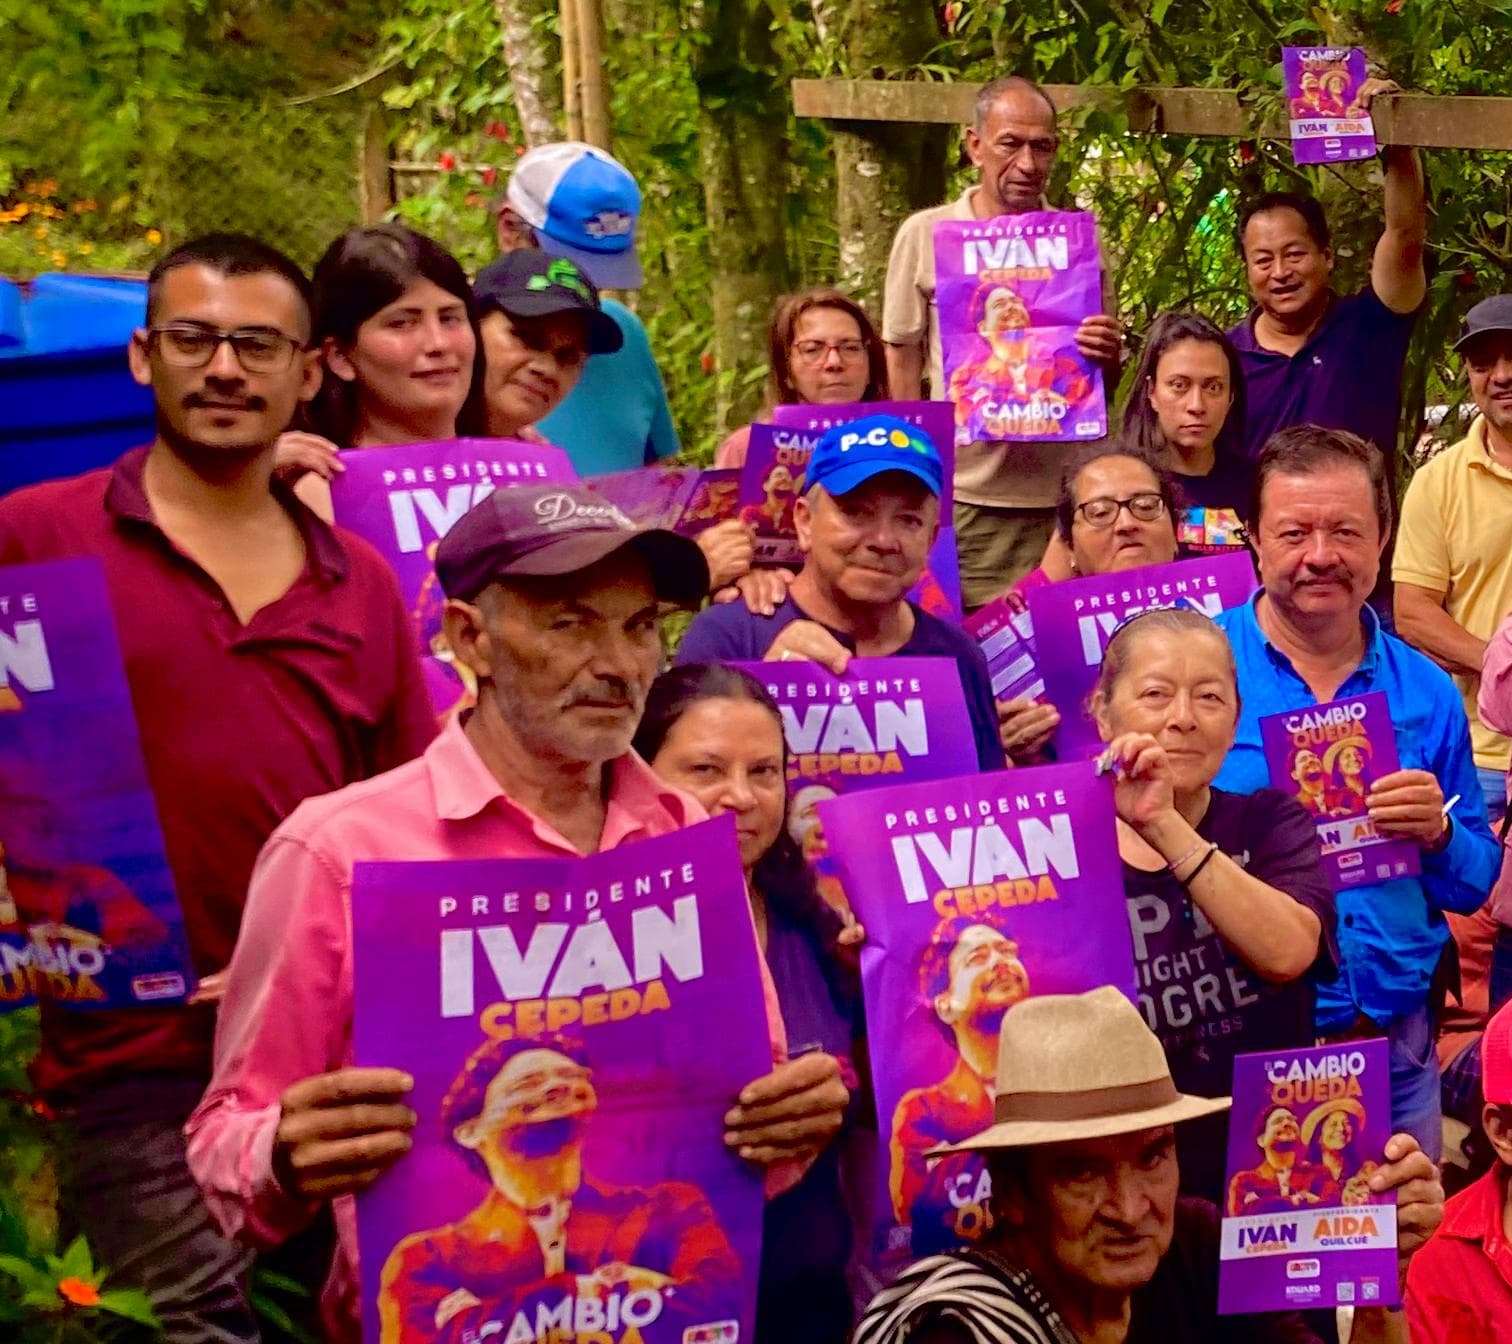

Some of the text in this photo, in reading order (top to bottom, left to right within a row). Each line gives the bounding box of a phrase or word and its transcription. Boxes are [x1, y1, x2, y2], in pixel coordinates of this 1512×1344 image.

[963, 235, 1069, 275] IVÁN
[982, 401, 1067, 420] CAMBIO
[383, 460, 548, 485] PRESIDENTE
[1074, 575, 1217, 611] PRESIDENTE
[768, 679, 921, 699] RESIDENTE
[779, 696, 929, 757] VÁN
[1286, 702, 1367, 733] CAMBIO
[1293, 719, 1368, 749] QUEDA
[885, 790, 1067, 829] PRESIDENTE
[891, 813, 1080, 904] IVÁN
[440, 862, 696, 917] PRESIDENTE
[933, 874, 1059, 919] CEPEDA
[440, 893, 704, 1018] IVÁN
[479, 978, 671, 1040] CEPEDA
[1267, 1052, 1366, 1084] CAMBIO
[1271, 1075, 1363, 1106] QUEDA
[1312, 1215, 1379, 1240] AIDA
